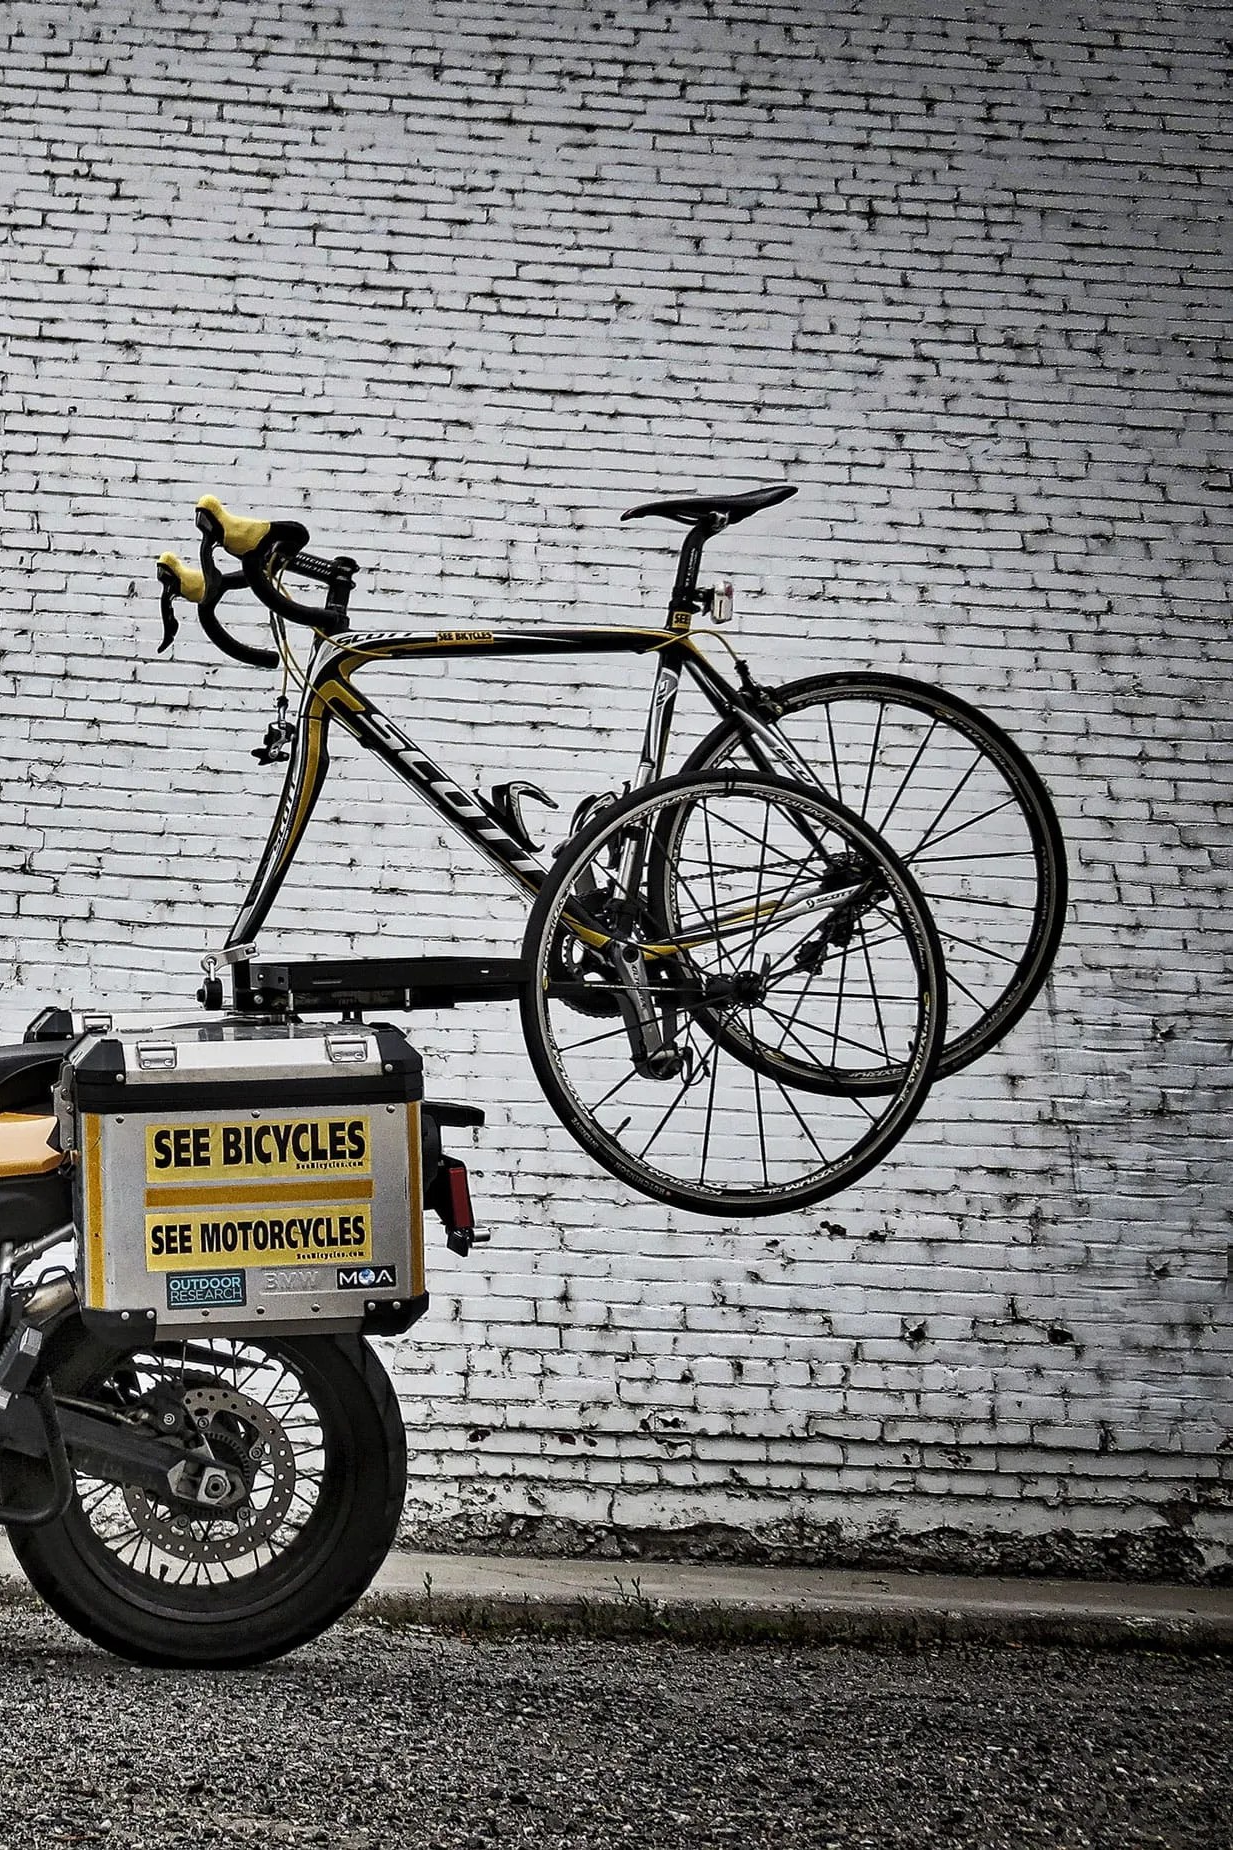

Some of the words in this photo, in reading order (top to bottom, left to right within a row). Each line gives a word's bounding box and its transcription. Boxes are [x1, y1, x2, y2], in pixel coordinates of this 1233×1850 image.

[674, 612, 689, 625] SEE
[333, 631, 413, 651] SCOTT
[437, 632, 454, 642] SEE
[455, 631, 493, 642] BICYCLES
[769, 746, 815, 783] SCO
[356, 713, 550, 876] SCOTT
[154, 1128, 212, 1169] SEE
[222, 1120, 366, 1166] BICYCLES
[151, 1224, 192, 1256] SEE
[201, 1215, 366, 1253] MOTORCYCLES
[169, 1276, 242, 1291] OUTDOOR
[264, 1271, 319, 1290] BMW
[170, 1286, 244, 1302] RESEARCH
